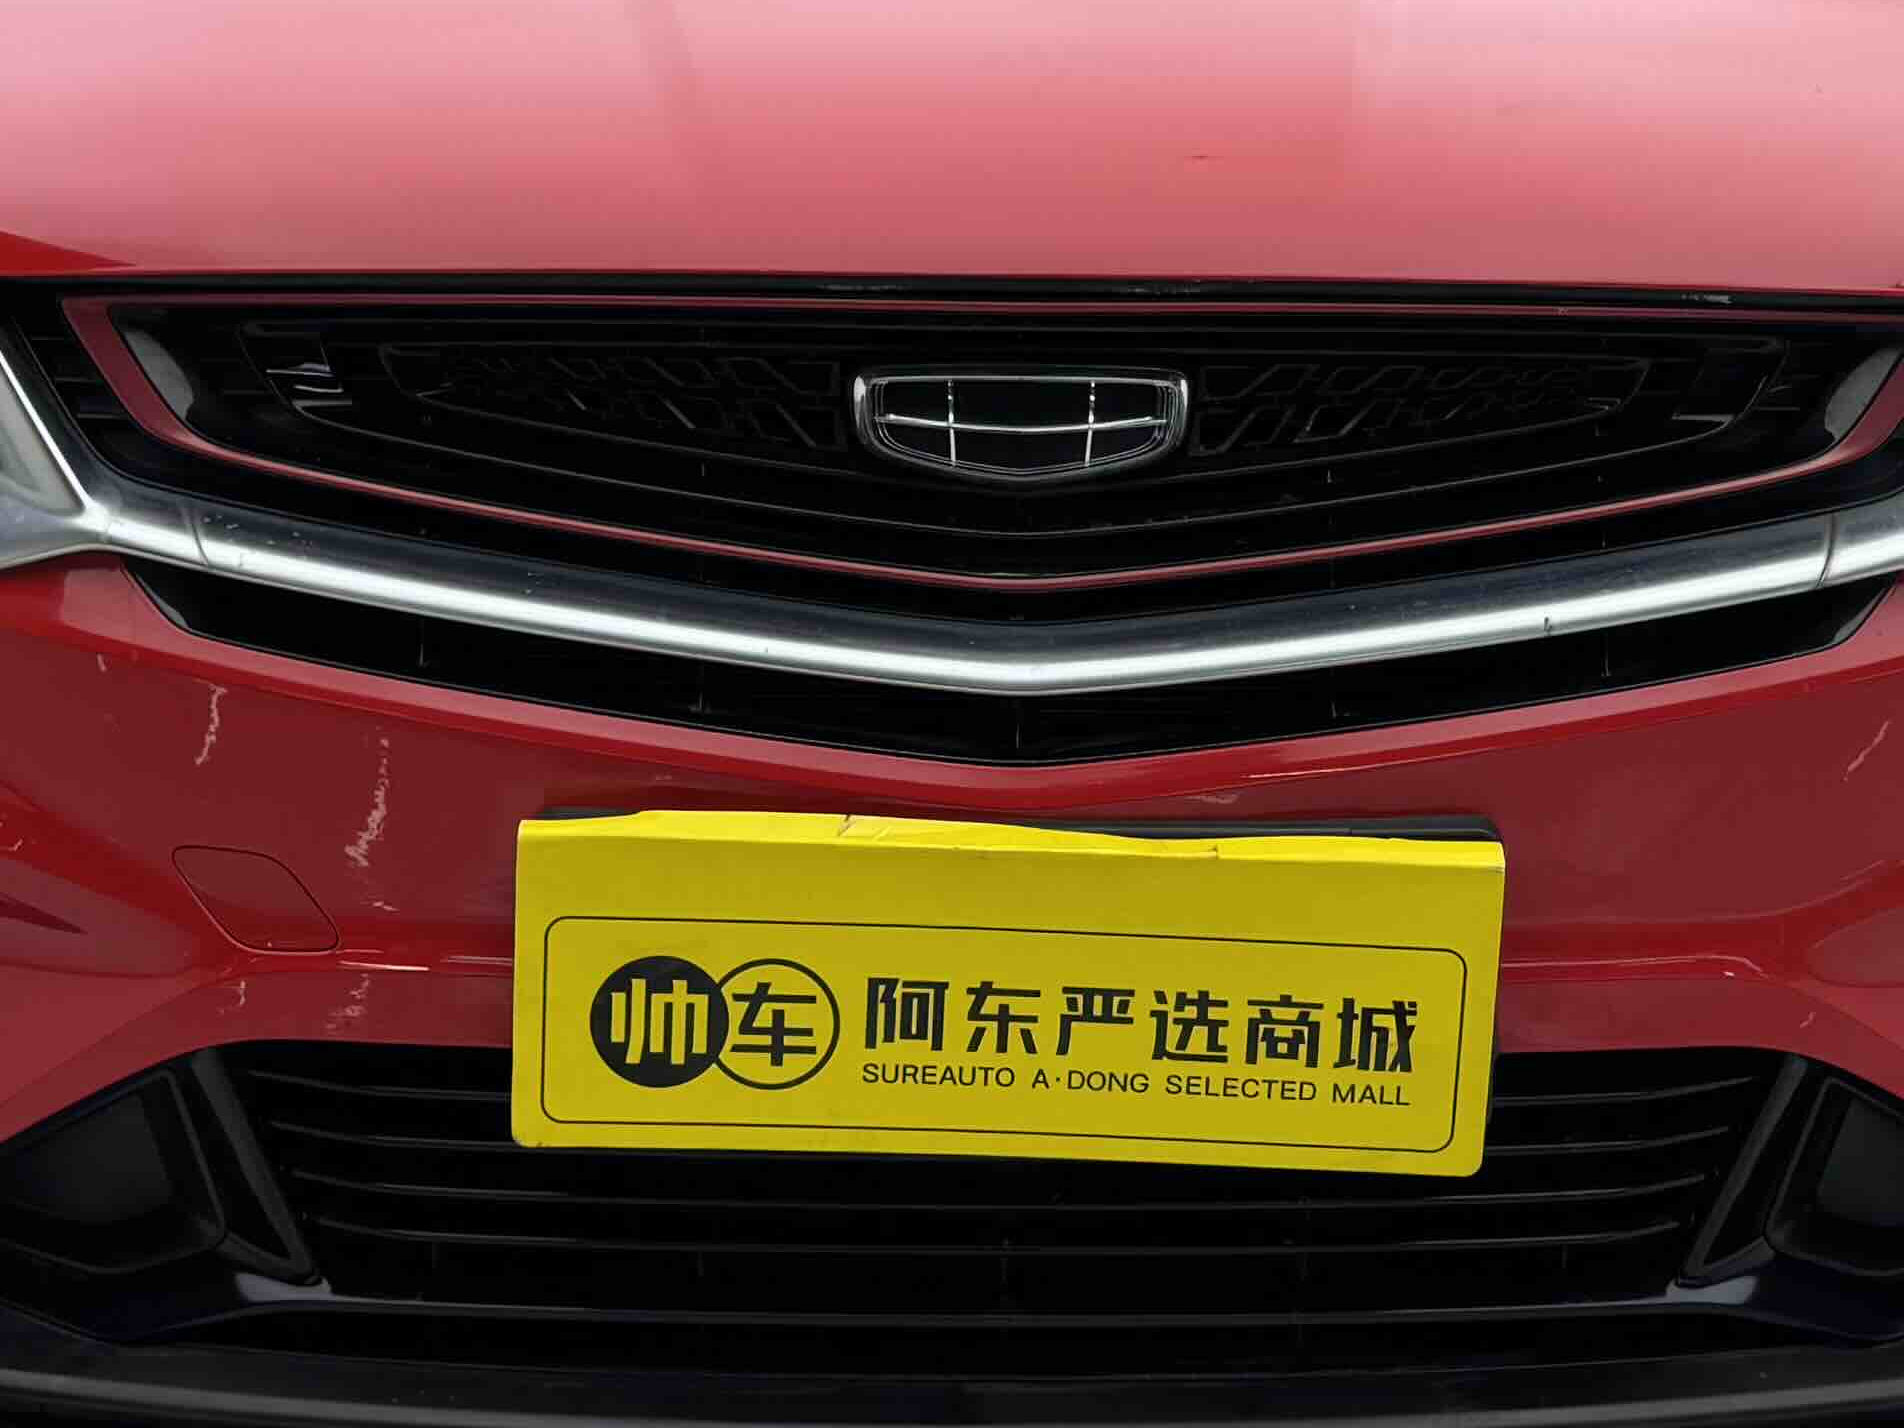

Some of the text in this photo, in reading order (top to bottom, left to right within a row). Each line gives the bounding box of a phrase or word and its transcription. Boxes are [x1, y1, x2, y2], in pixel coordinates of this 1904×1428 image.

[608, 976, 1418, 1072] 帅车 阿东严选商城
[861, 1063, 1016, 1088] SUREAUTO
[1164, 1074, 1317, 1101] SELECTED
[1331, 1083, 1412, 1107] MALL
